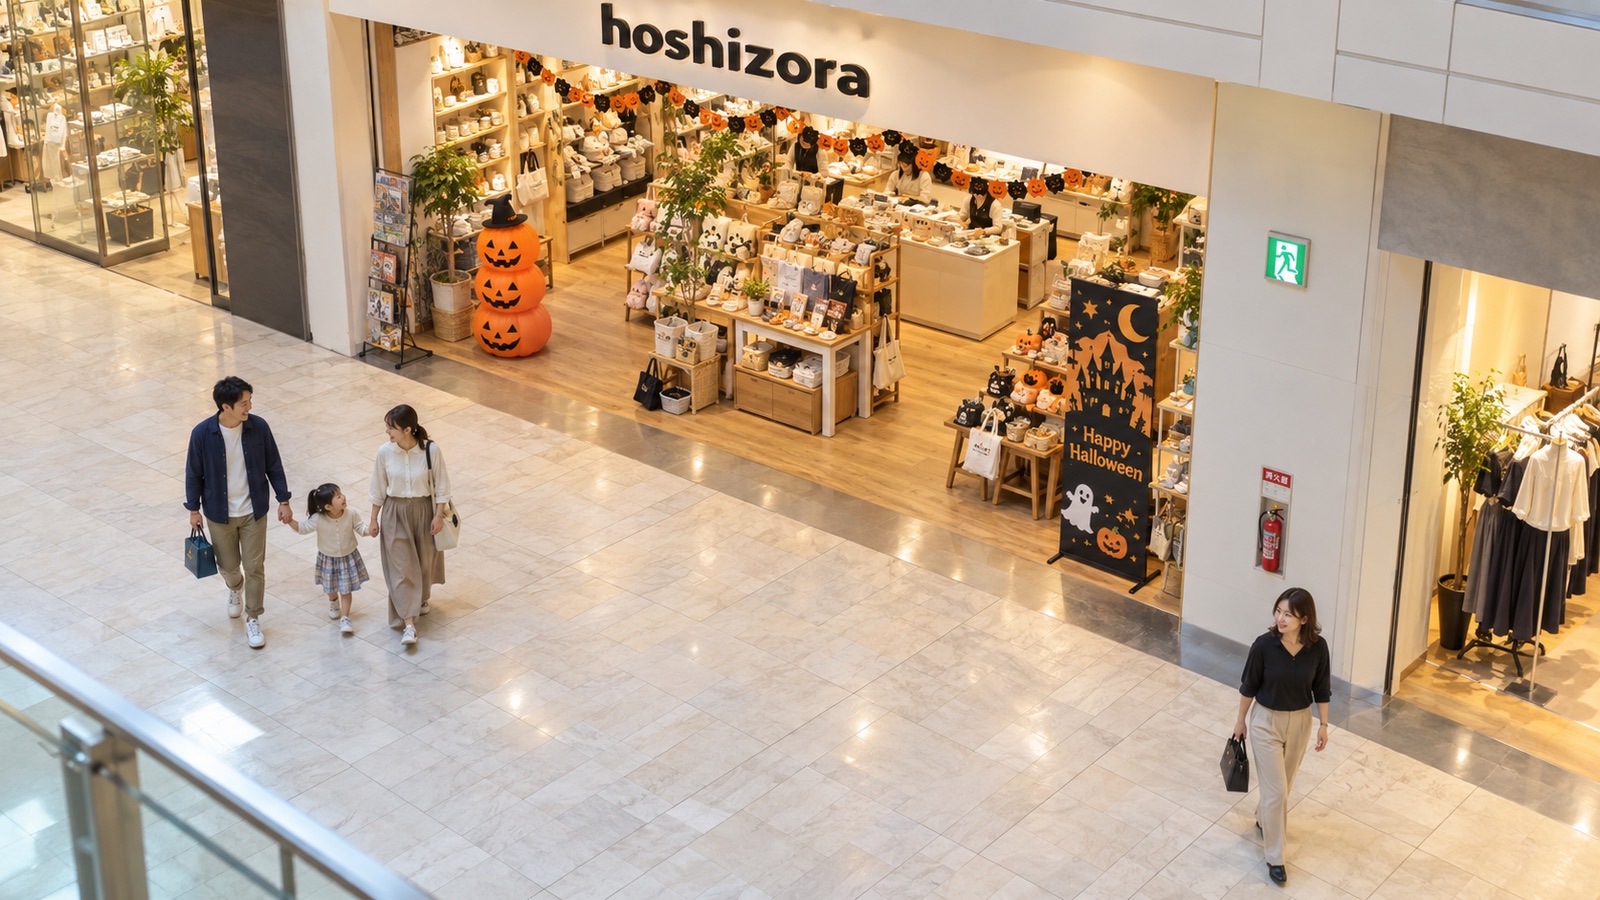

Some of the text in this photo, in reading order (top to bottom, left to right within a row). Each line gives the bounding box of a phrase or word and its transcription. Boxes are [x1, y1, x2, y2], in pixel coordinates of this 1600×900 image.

[601, 2, 870, 98] hoshizora
[1083, 425, 1131, 458] Happy
[1069, 442, 1143, 482] Halloween
